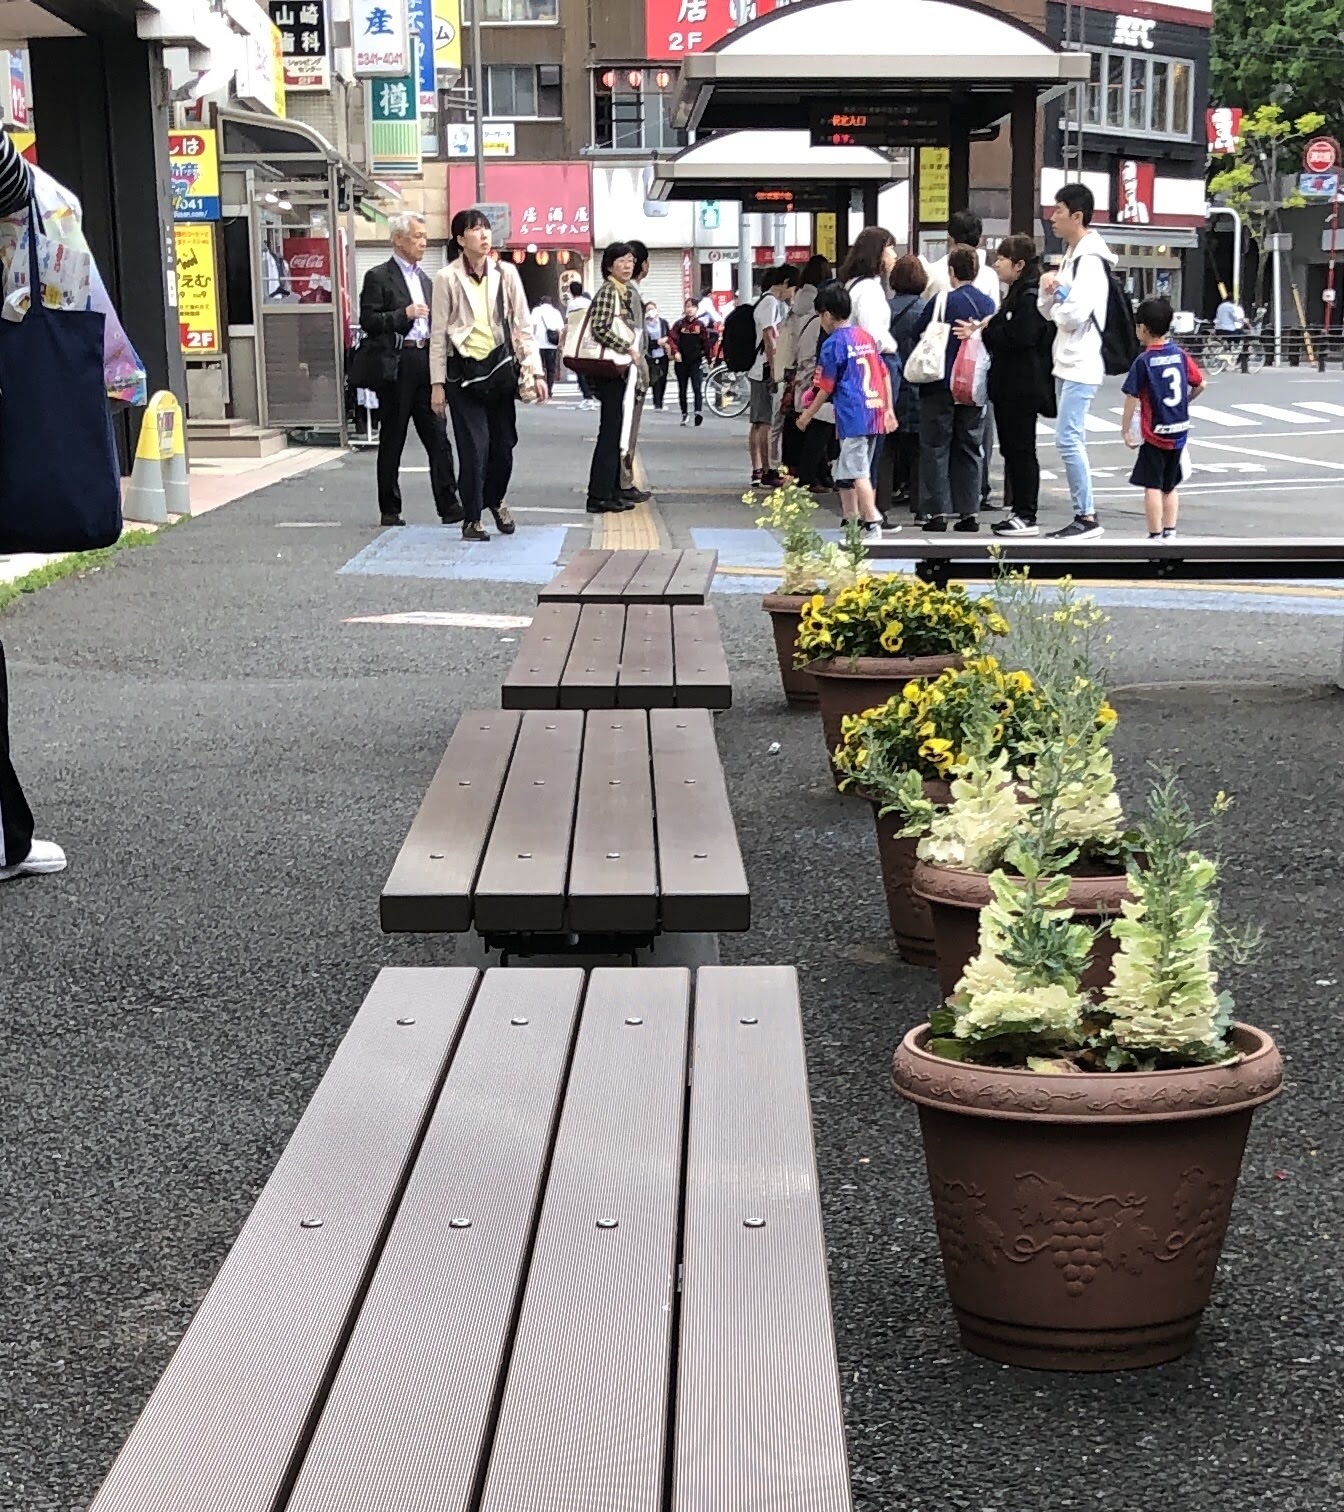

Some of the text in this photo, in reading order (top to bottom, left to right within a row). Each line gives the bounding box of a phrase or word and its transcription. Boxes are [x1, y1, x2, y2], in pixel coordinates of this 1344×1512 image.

[275, 4, 319, 26] 山崎
[668, 31, 703, 51] 2F
[379, 82, 410, 117] 樽
[521, 206, 589, 223] 居酒屋
[186, 331, 214, 348] 2F
[856, 356, 879, 398] 2
[1161, 367, 1183, 408] 3
